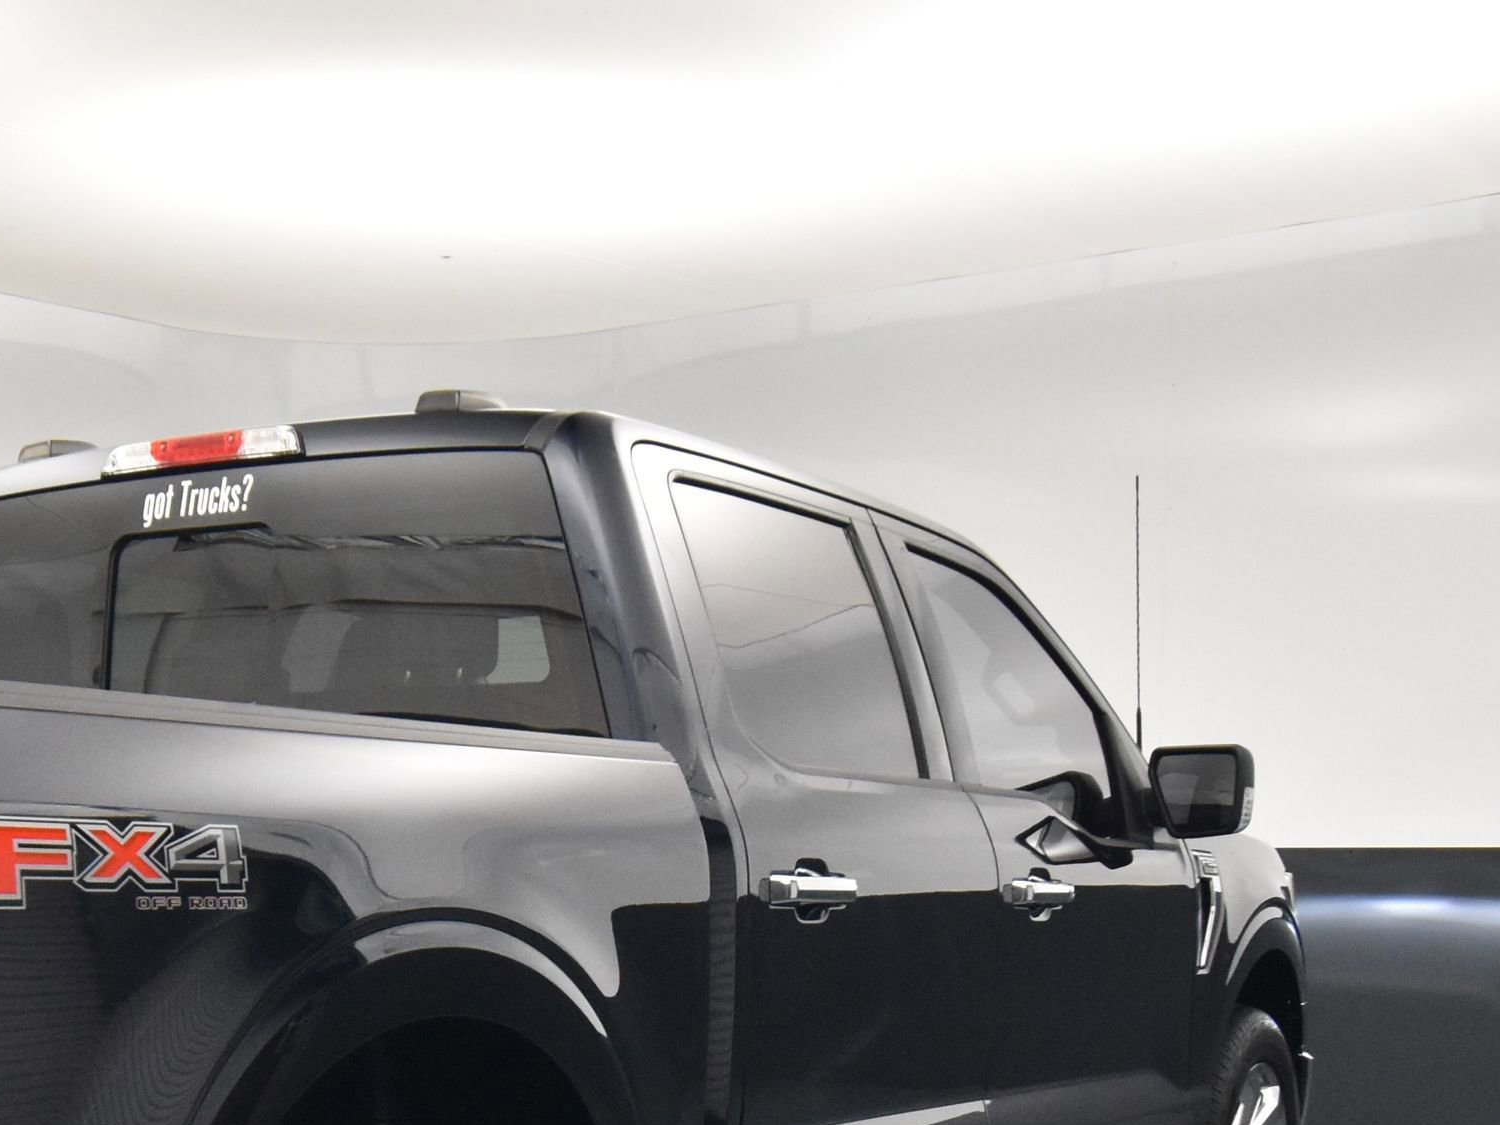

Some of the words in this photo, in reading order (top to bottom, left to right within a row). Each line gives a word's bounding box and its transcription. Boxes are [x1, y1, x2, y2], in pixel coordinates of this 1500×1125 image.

[143, 483, 174, 528] got
[180, 473, 254, 518] Trucks?
[136, 896, 181, 910] OFF
[189, 896, 248, 910] ROAD
